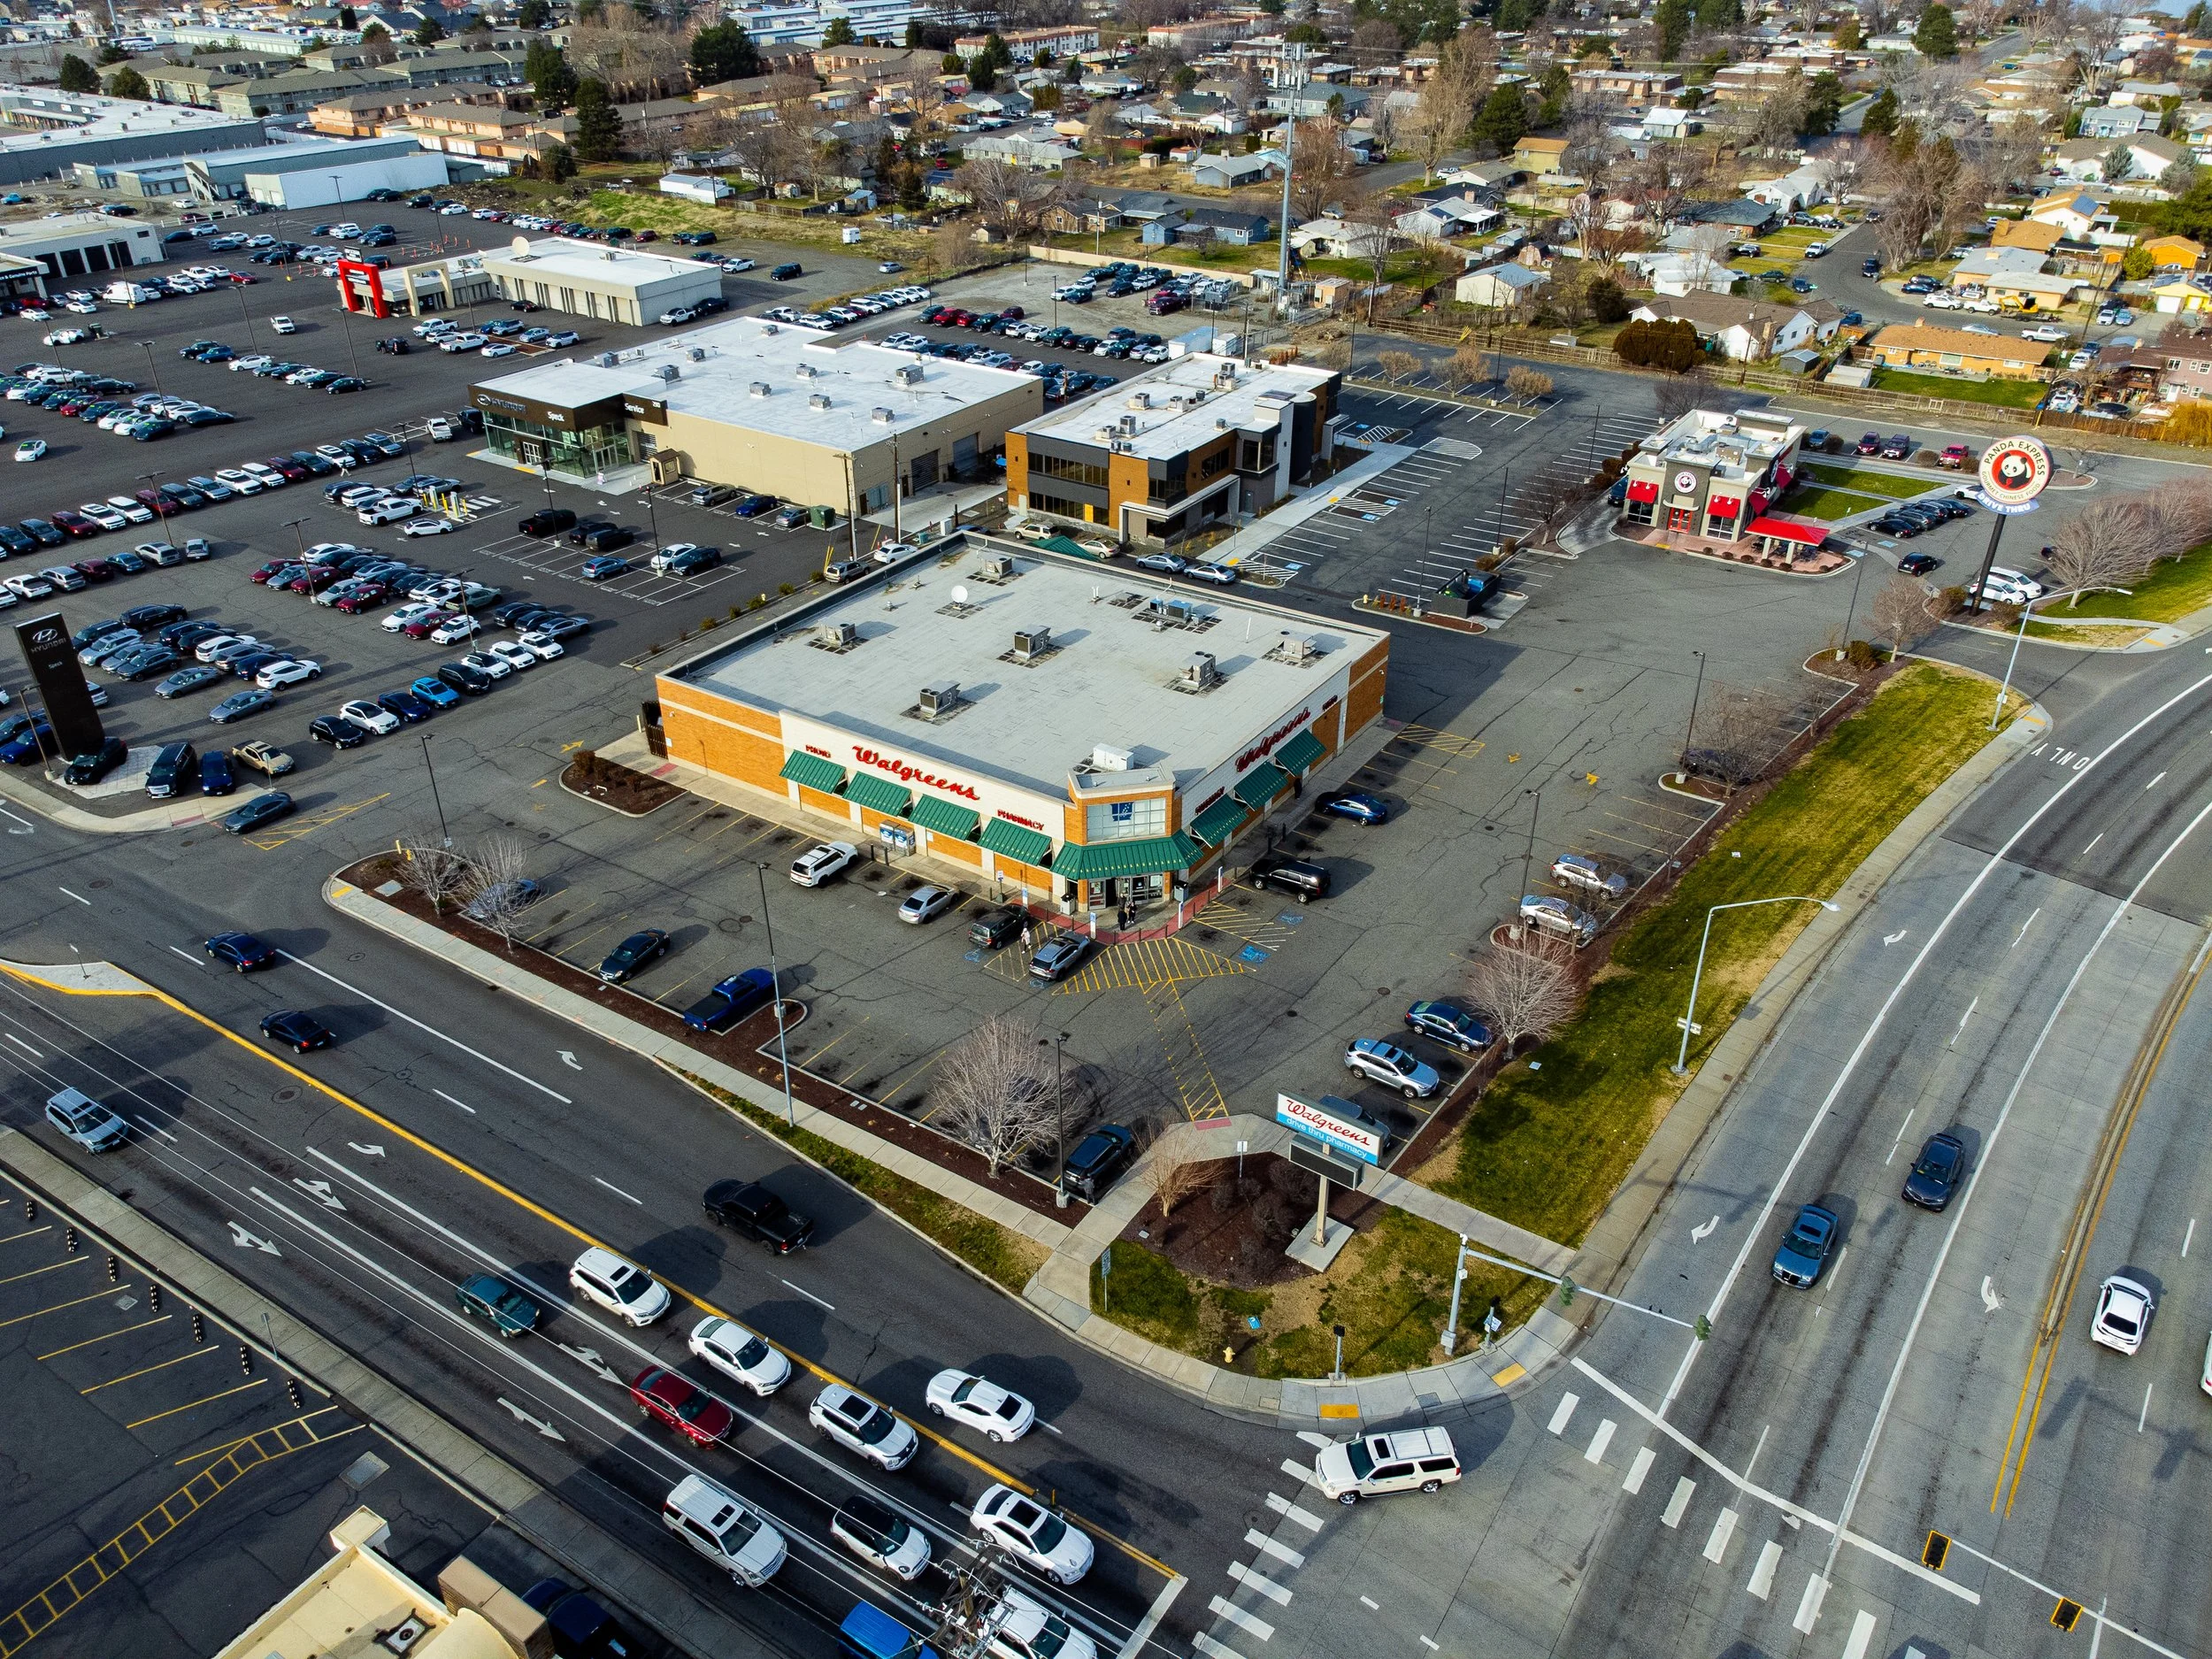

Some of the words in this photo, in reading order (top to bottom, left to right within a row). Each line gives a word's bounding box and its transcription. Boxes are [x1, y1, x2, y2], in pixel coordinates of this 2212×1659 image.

[547, 411, 565, 422] Speck
[624, 403, 645, 414] Service
[1984, 441, 2015, 465] PANDA
[2017, 441, 2046, 476] EXPRESS
[1982, 471, 1999, 495] GOURMET
[2025, 483, 2040, 496] FOOD
[1977, 492, 2004, 511] DRIVE
[2005, 503, 2031, 513] THRU
[30, 637, 67, 654] HYUNDAI
[2031, 742, 2090, 771] ONLY
[852, 746, 980, 801] Walgreens
[997, 810, 1044, 831] PHARMACY
[1286, 1099, 1371, 1146] Walgreens
[1286, 1117, 1307, 1131] drive
[1308, 1125, 1325, 1140] thru
[1326, 1135, 1367, 1158] pharmacy
